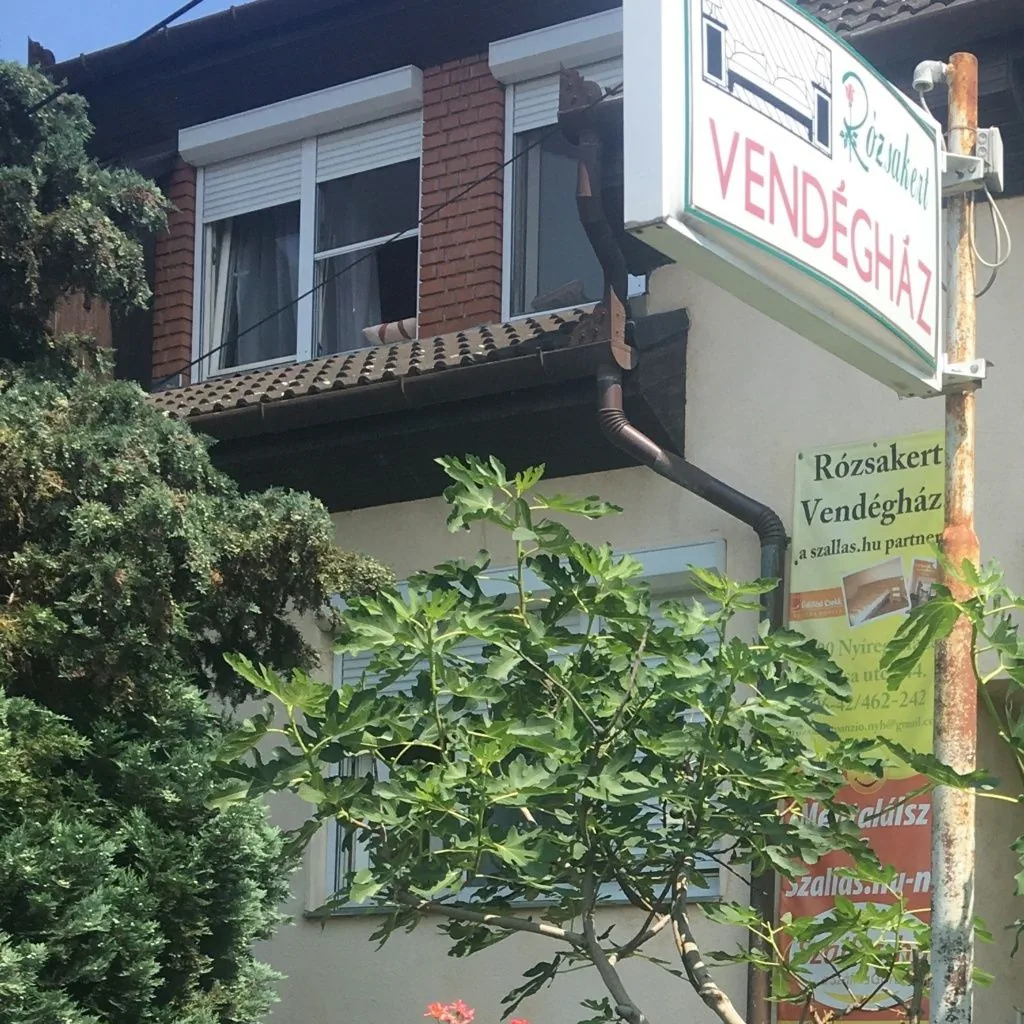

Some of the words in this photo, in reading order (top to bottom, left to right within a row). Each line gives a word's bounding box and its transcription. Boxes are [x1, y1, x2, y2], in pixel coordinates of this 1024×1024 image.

[708, 117, 932, 337] VENDÉGHÁZ
[813, 443, 943, 482] Rózsakert
[801, 487, 942, 527] Vendégház
[799, 549, 807, 560] a
[811, 536, 881, 560] szallas.hu
[797, 795, 931, 830] Mealálsz
